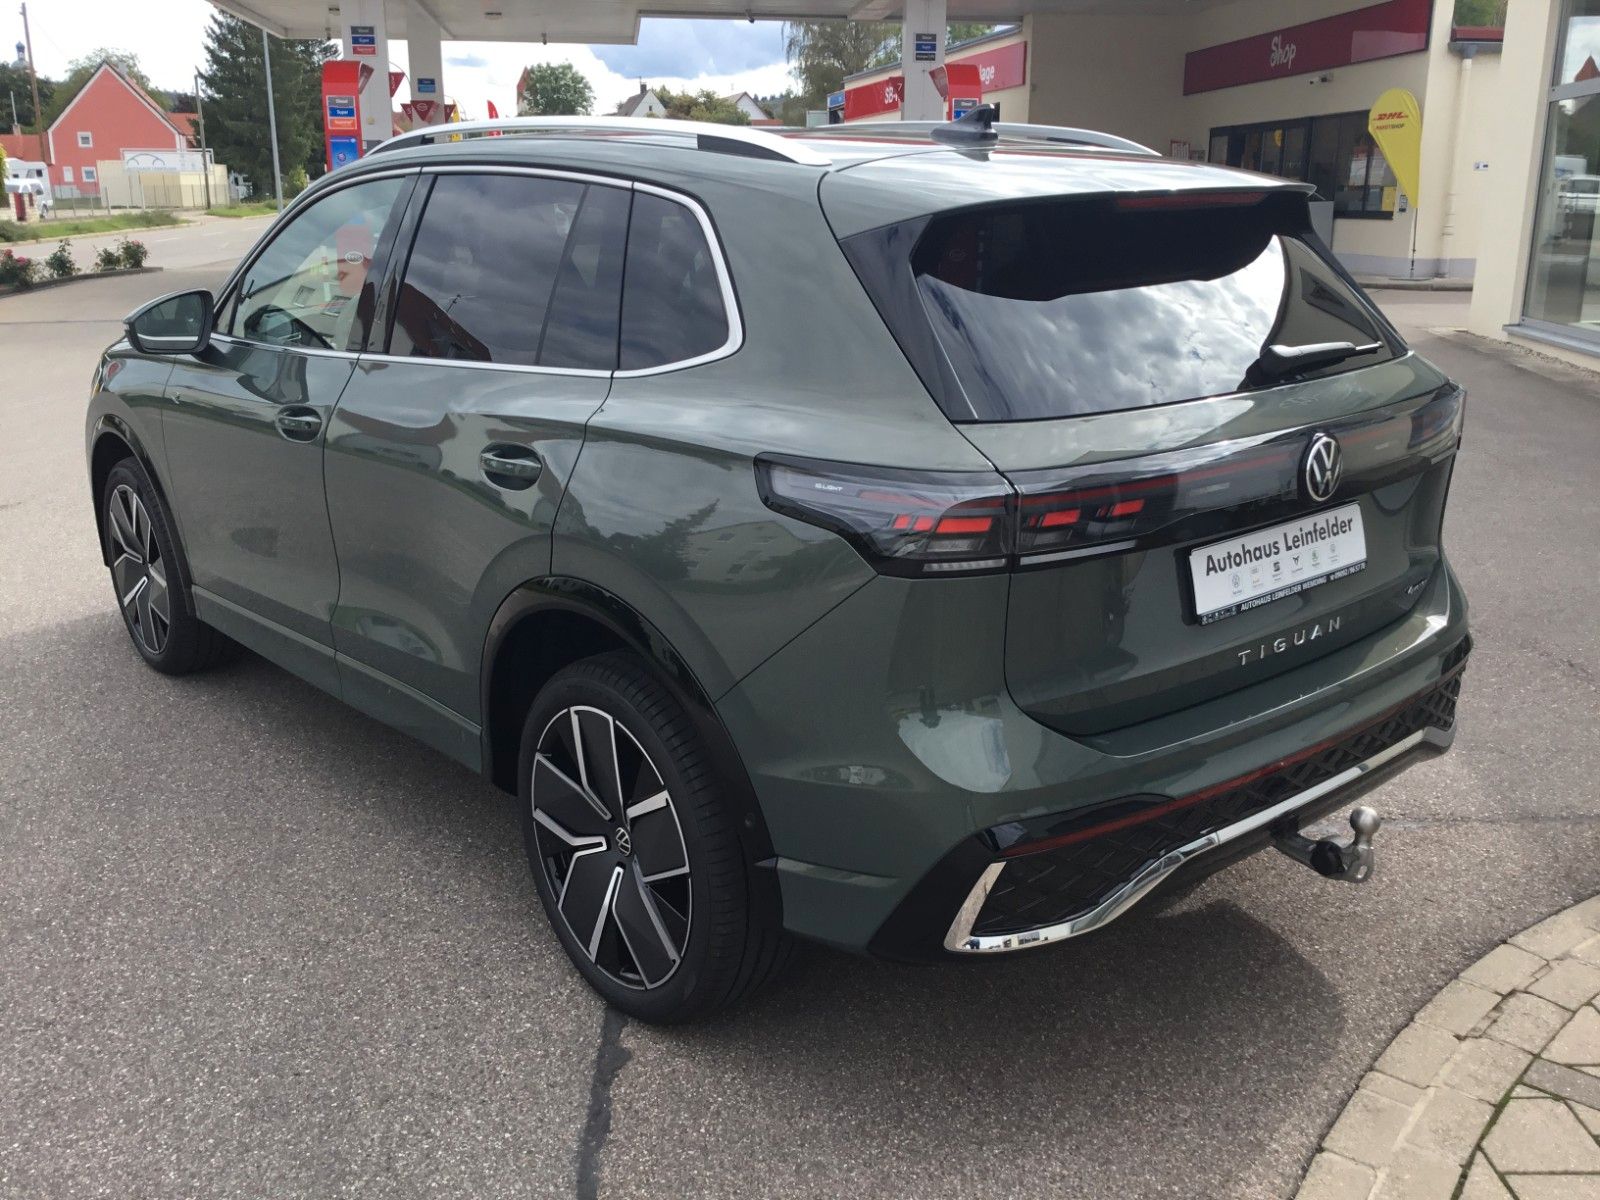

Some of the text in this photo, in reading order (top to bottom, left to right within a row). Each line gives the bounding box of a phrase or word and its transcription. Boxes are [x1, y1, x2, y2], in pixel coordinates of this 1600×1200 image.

[1270, 34, 1297, 69] Shop
[1375, 111, 1406, 121] DHL
[1205, 515, 1354, 577] Autohaus Leinfelder
[1240, 595, 1272, 612] AUTOHAUS
[1271, 584, 1302, 601] LEINFELDER
[1237, 616, 1342, 667] TIGUAN
